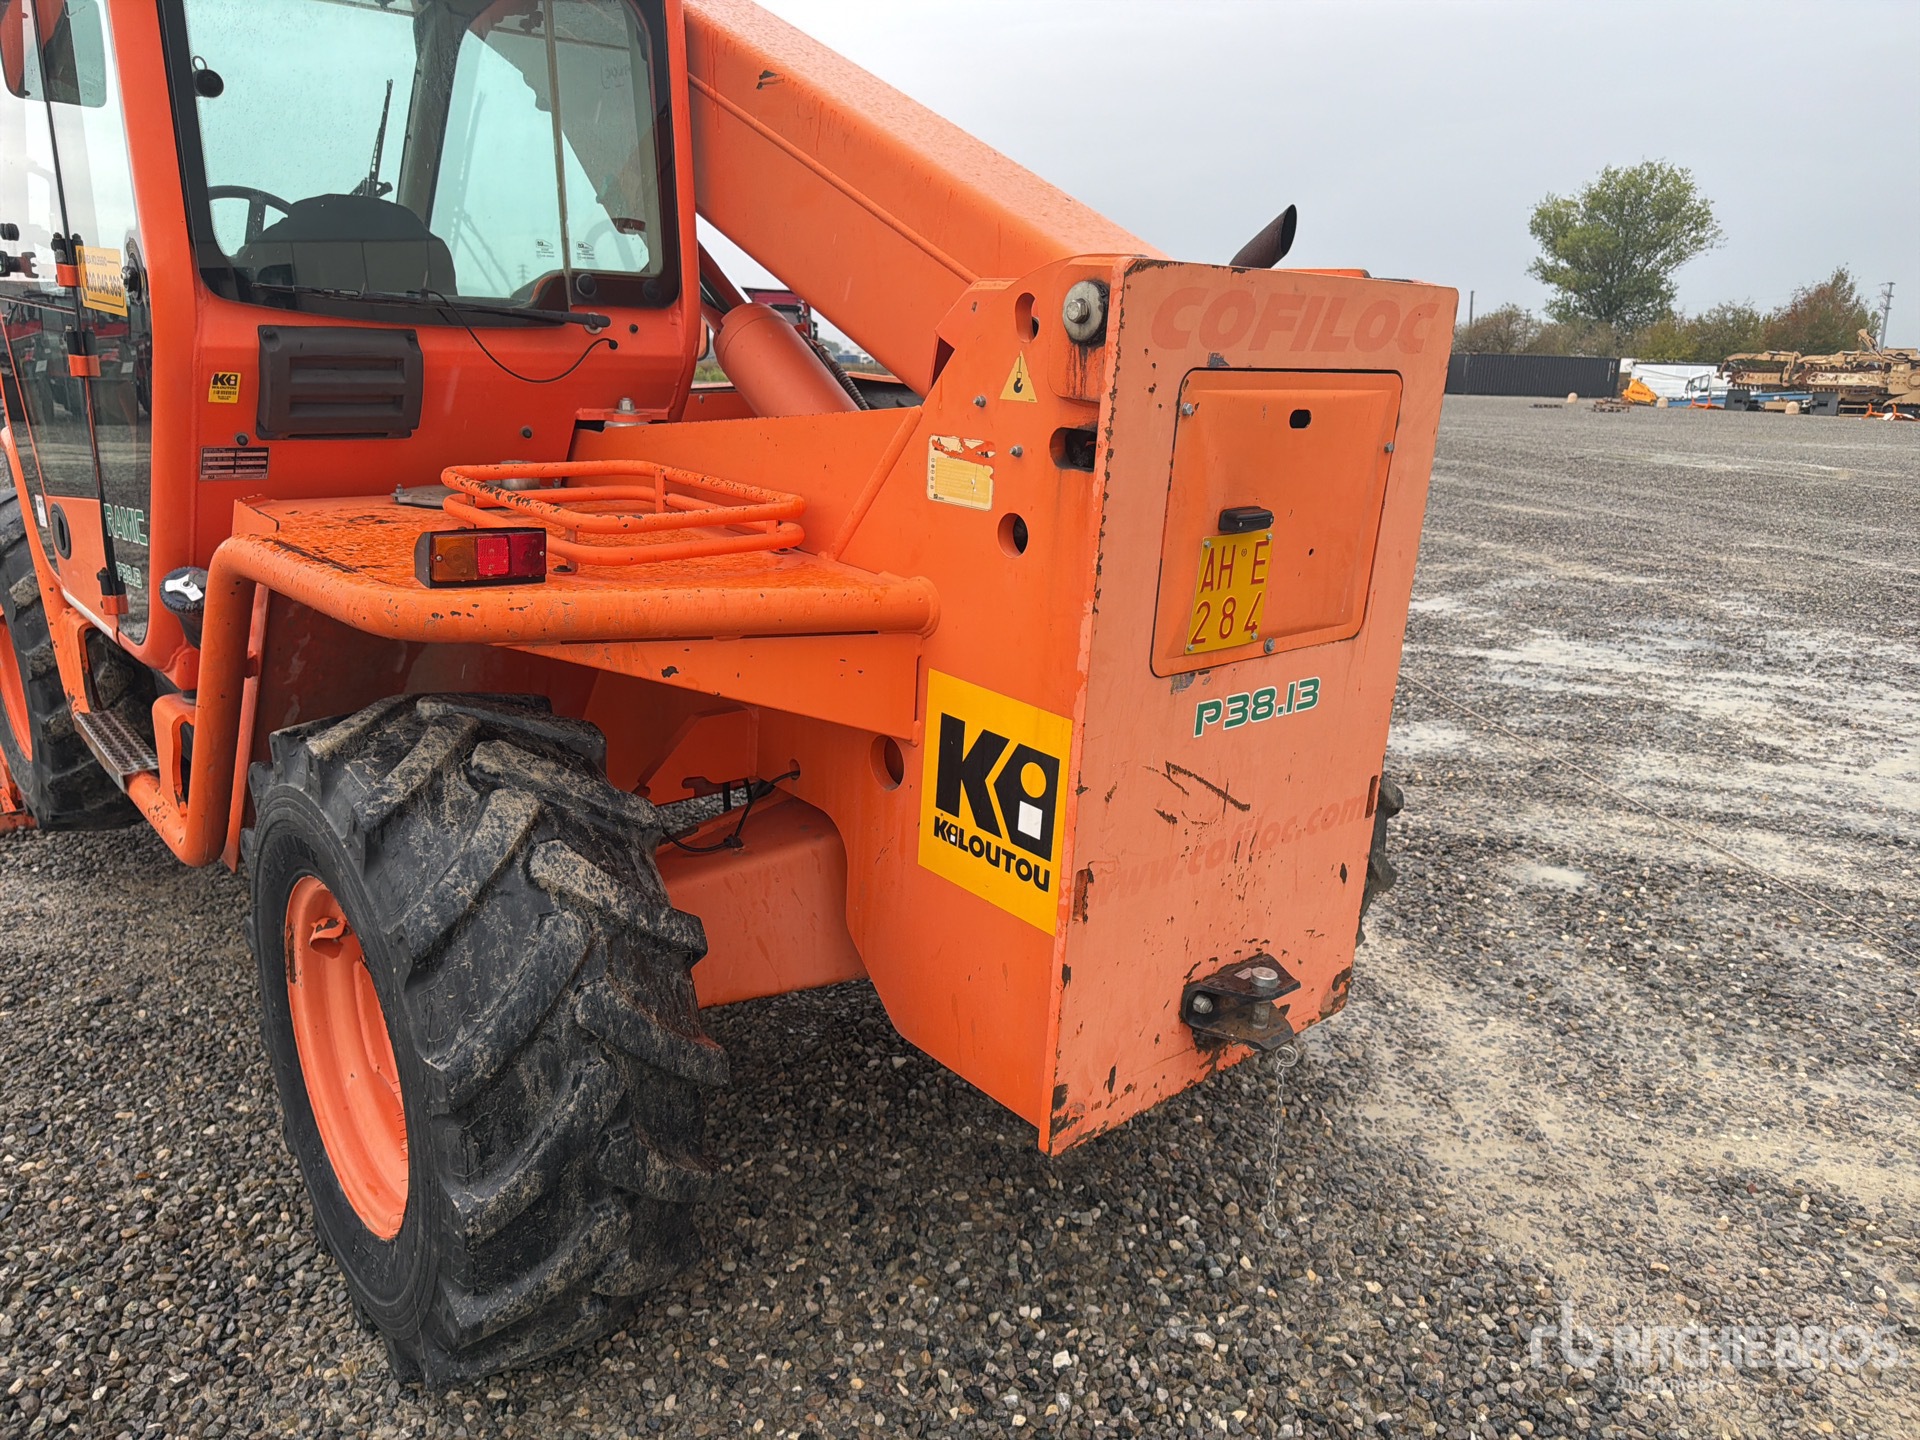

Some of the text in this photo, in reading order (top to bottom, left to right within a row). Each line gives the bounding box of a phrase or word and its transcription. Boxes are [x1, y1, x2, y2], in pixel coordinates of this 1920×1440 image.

[1151, 286, 1440, 354] COFILOC
[1199, 544, 1237, 594] AH
[1191, 591, 1262, 645] 284
[1193, 676, 1321, 738] P38.13
